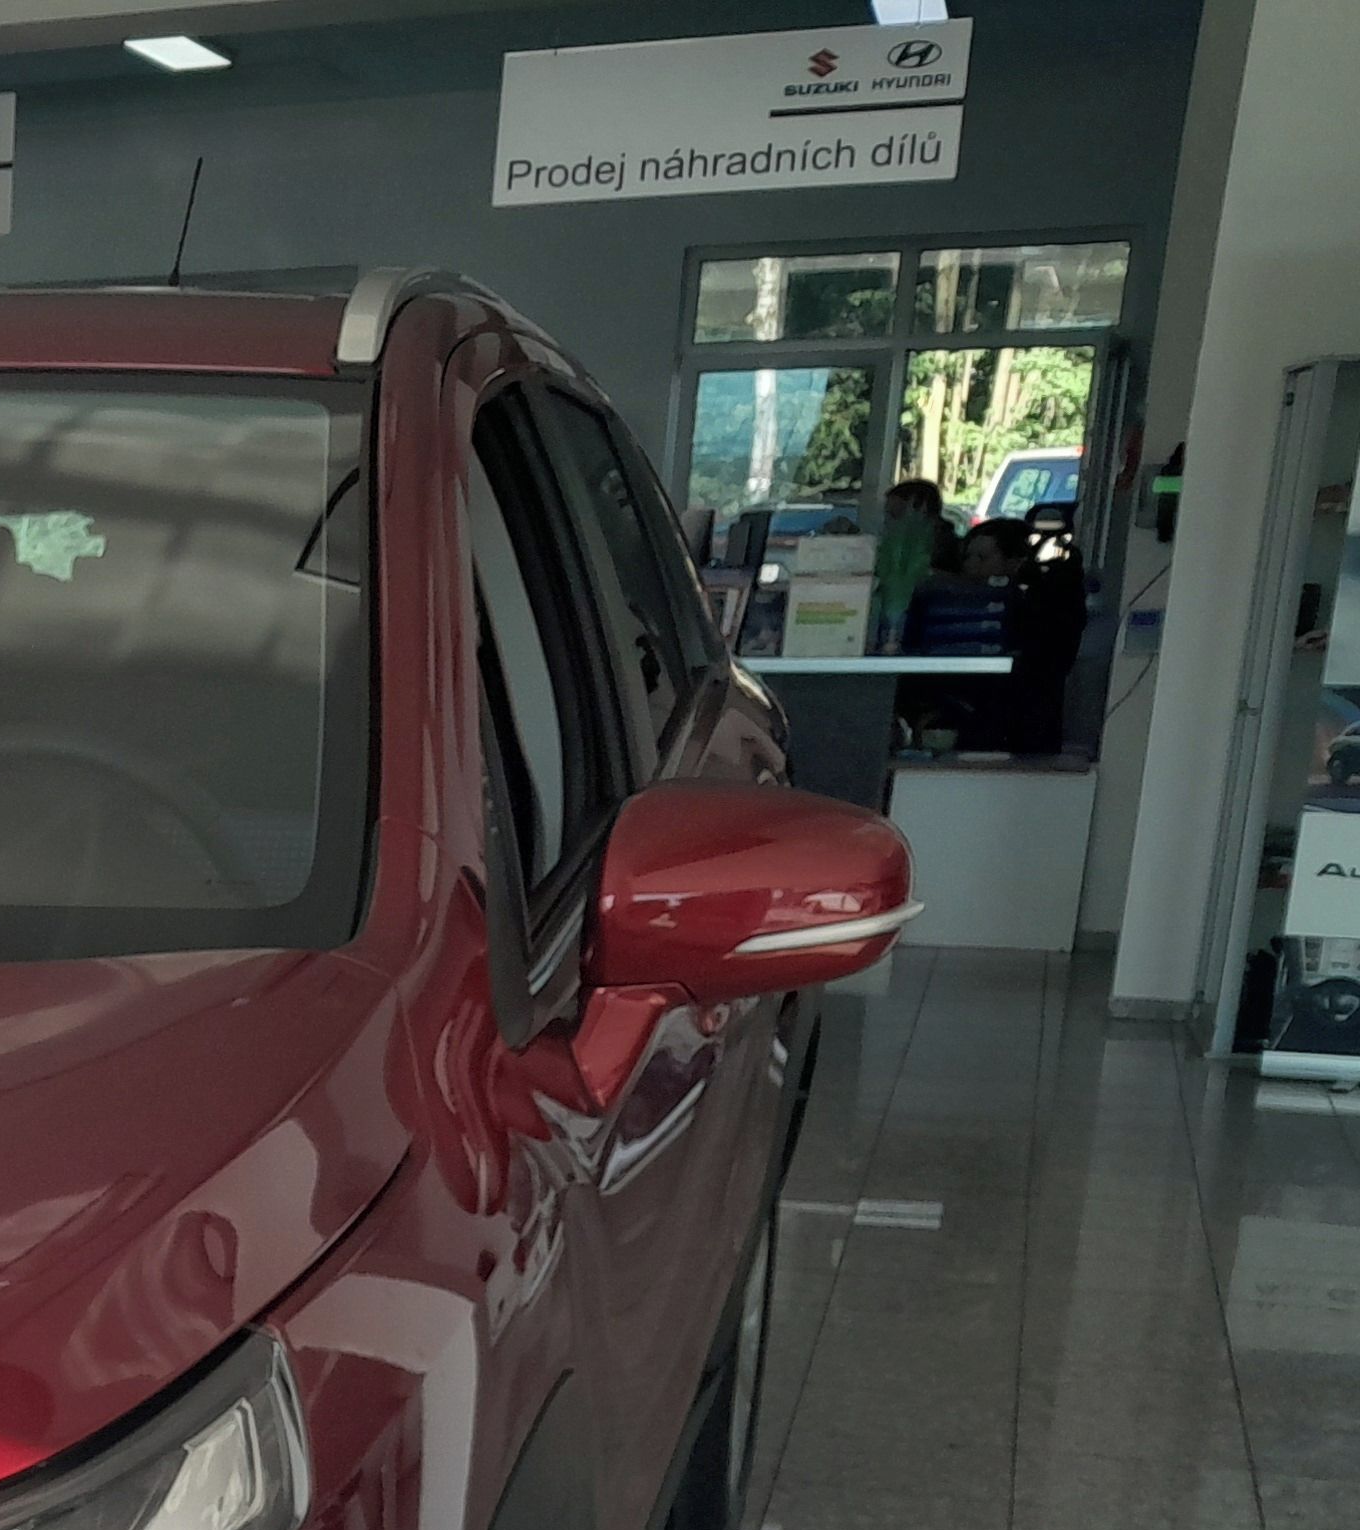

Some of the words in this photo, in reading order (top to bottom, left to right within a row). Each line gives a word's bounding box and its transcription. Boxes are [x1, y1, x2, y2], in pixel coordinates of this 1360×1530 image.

[783, 81, 859, 96] SUZUKI
[871, 73, 952, 90] HYUNDAI
[506, 153, 626, 192] Prodej
[639, 138, 856, 183] náhradních
[871, 131, 942, 167] dílů
